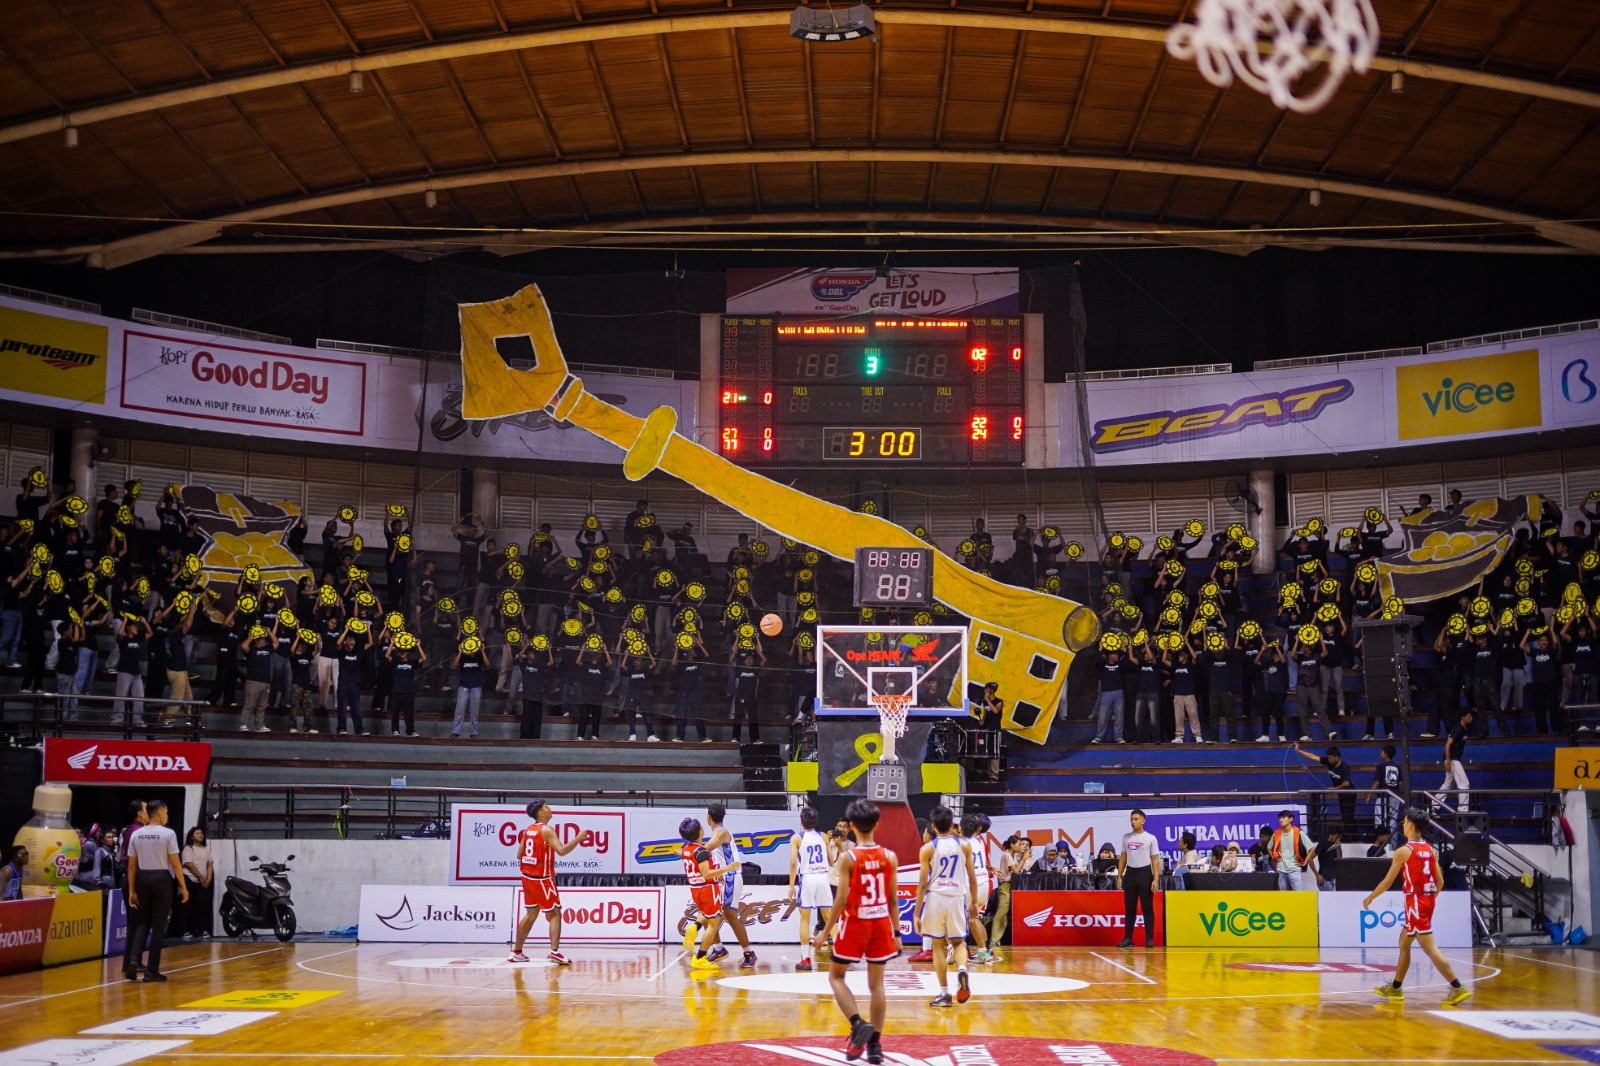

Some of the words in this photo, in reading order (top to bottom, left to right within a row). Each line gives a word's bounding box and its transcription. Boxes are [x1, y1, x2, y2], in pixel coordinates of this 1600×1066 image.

[886, 274, 919, 288] LET'S
[0, 339, 96, 366] proteam
[867, 357, 877, 374] 3
[166, 394, 202, 407] KARENA
[205, 400, 230, 411] HIDUP
[232, 403, 257, 414] PERLU
[259, 406, 292, 418] BANYAK
[296, 410, 316, 420] RASA
[97, 754, 192, 771] HONDA
[525, 838, 534, 857] 8
[806, 845, 823, 864] 23
[479, 860, 508, 868] KARENA
[939, 855, 959, 878] 27
[861, 872, 887, 905] 31
[422, 903, 496, 923] Jackson
